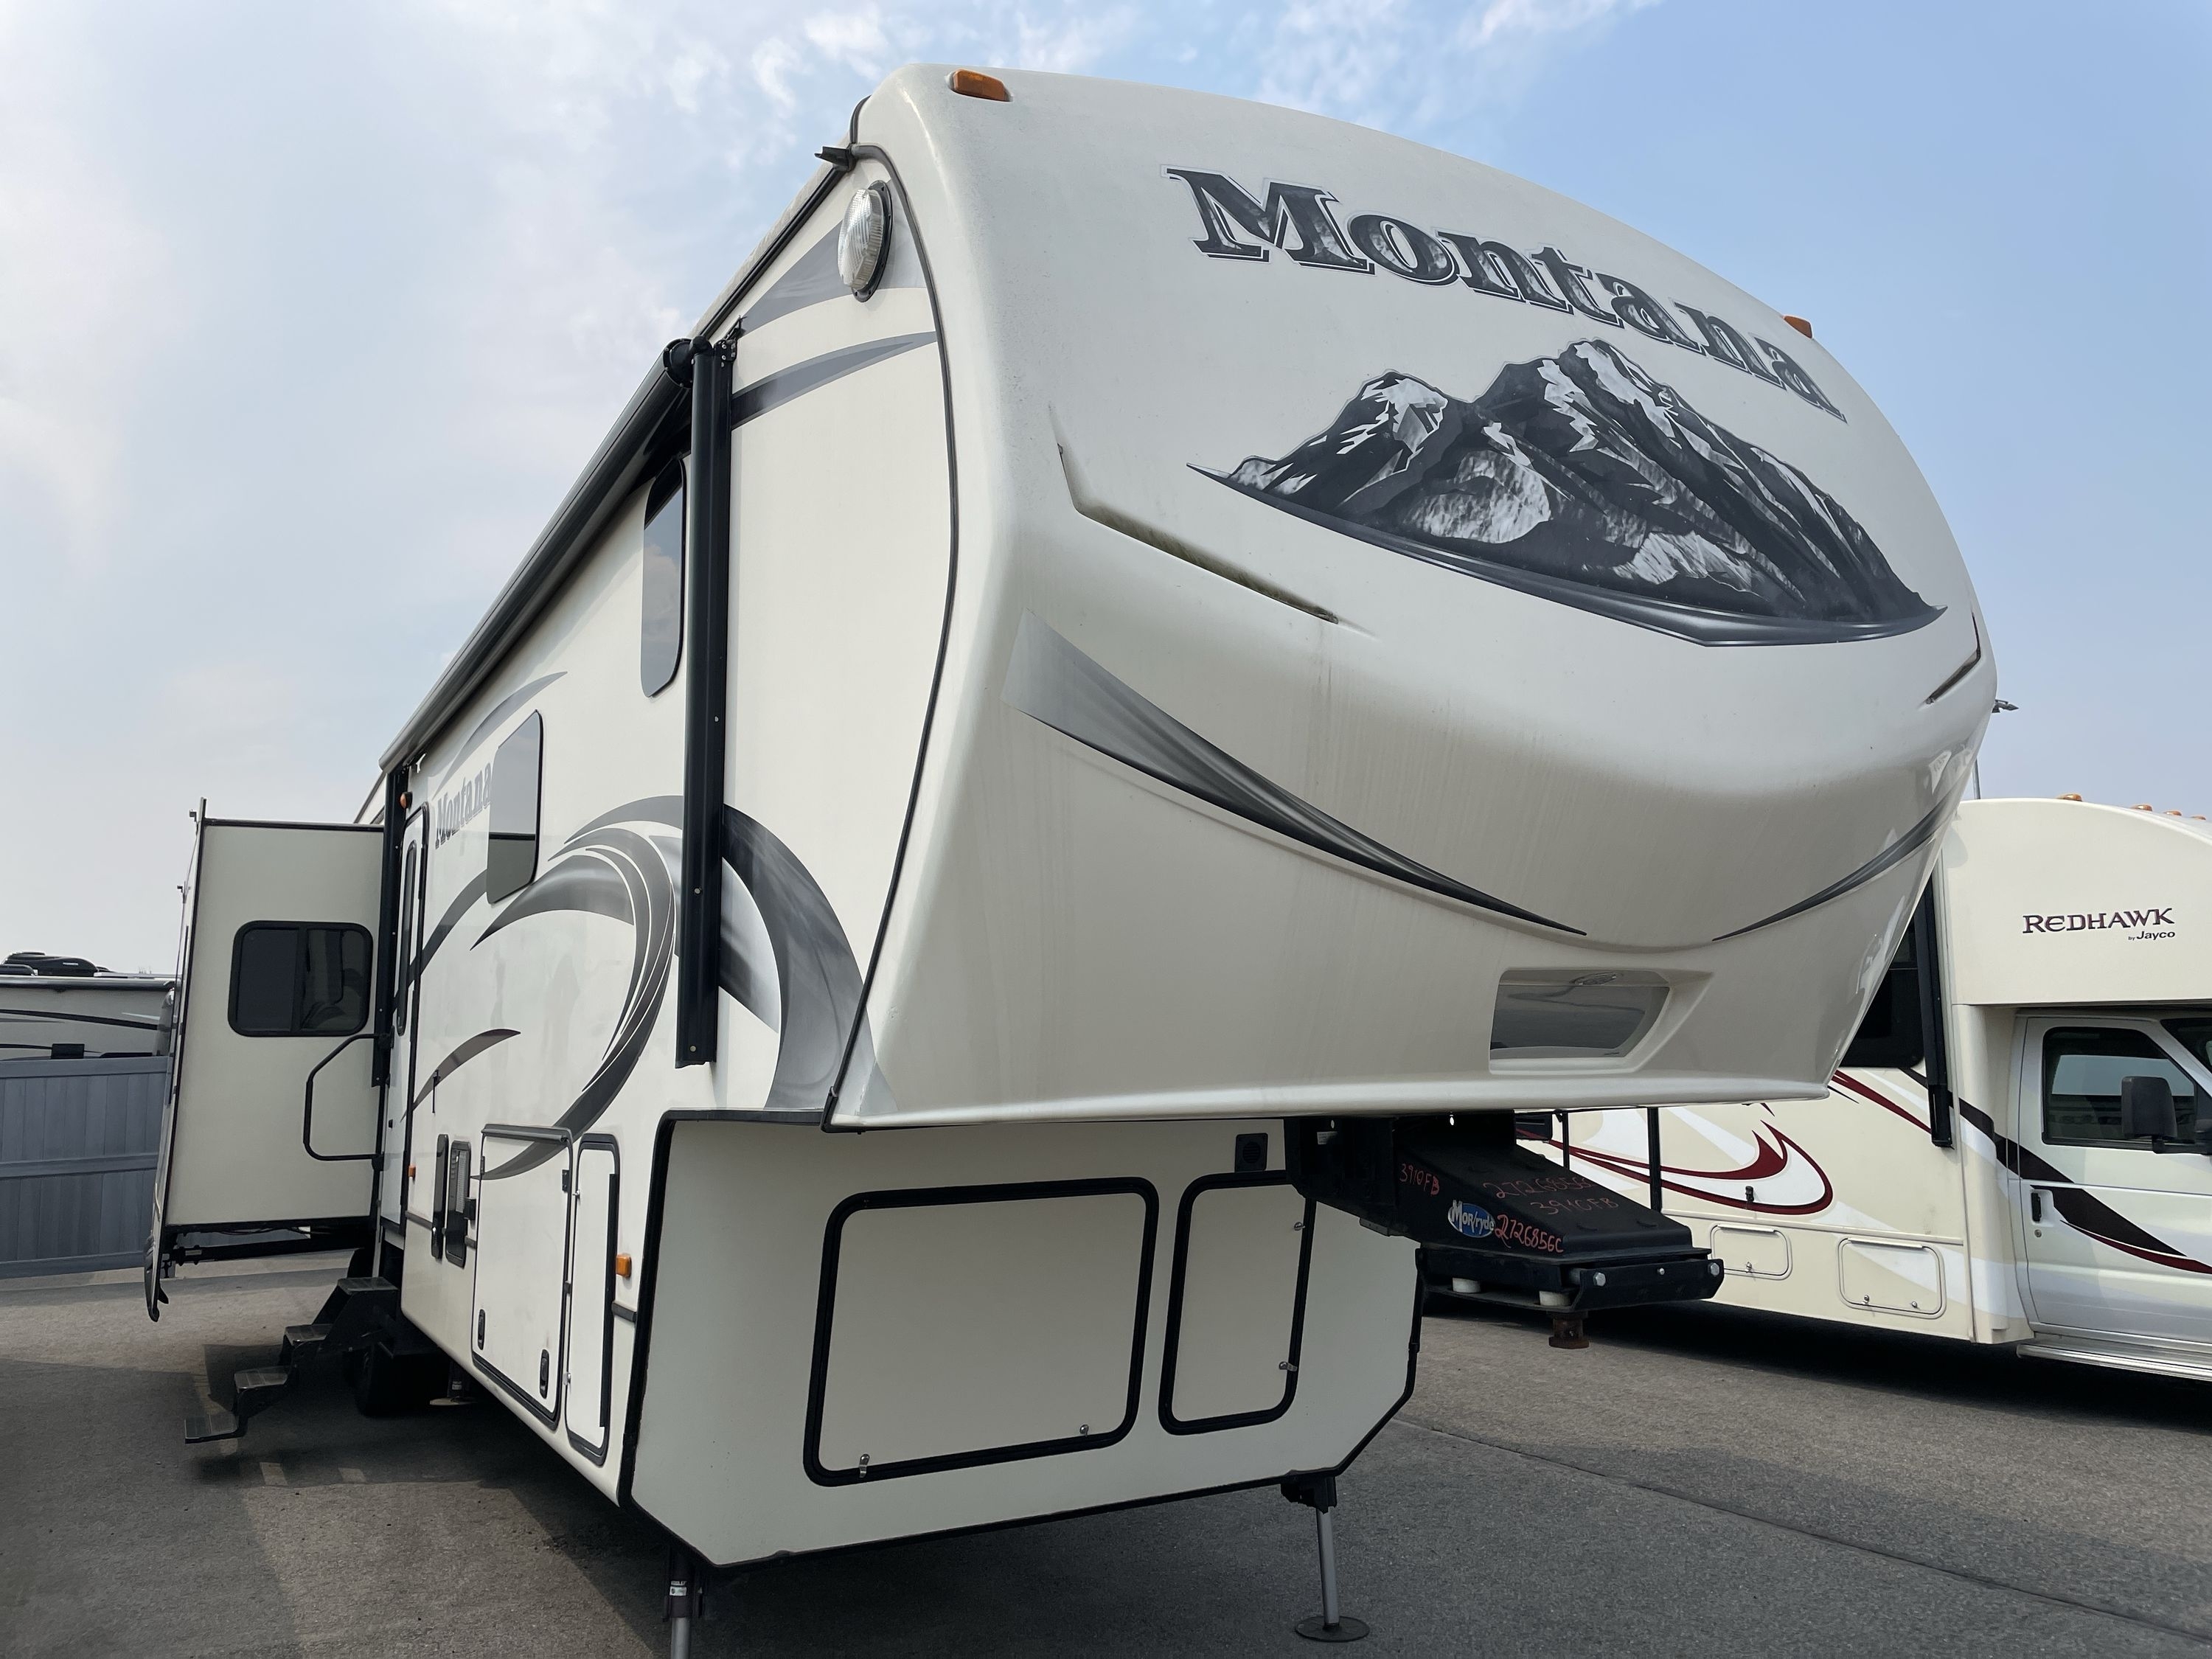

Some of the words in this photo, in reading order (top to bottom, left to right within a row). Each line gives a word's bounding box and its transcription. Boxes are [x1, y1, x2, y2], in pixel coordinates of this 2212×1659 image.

[1165, 167, 1848, 424] Montana
[2023, 908, 2175, 933] REDHAWK
[2136, 931, 2176, 941] Jayco
